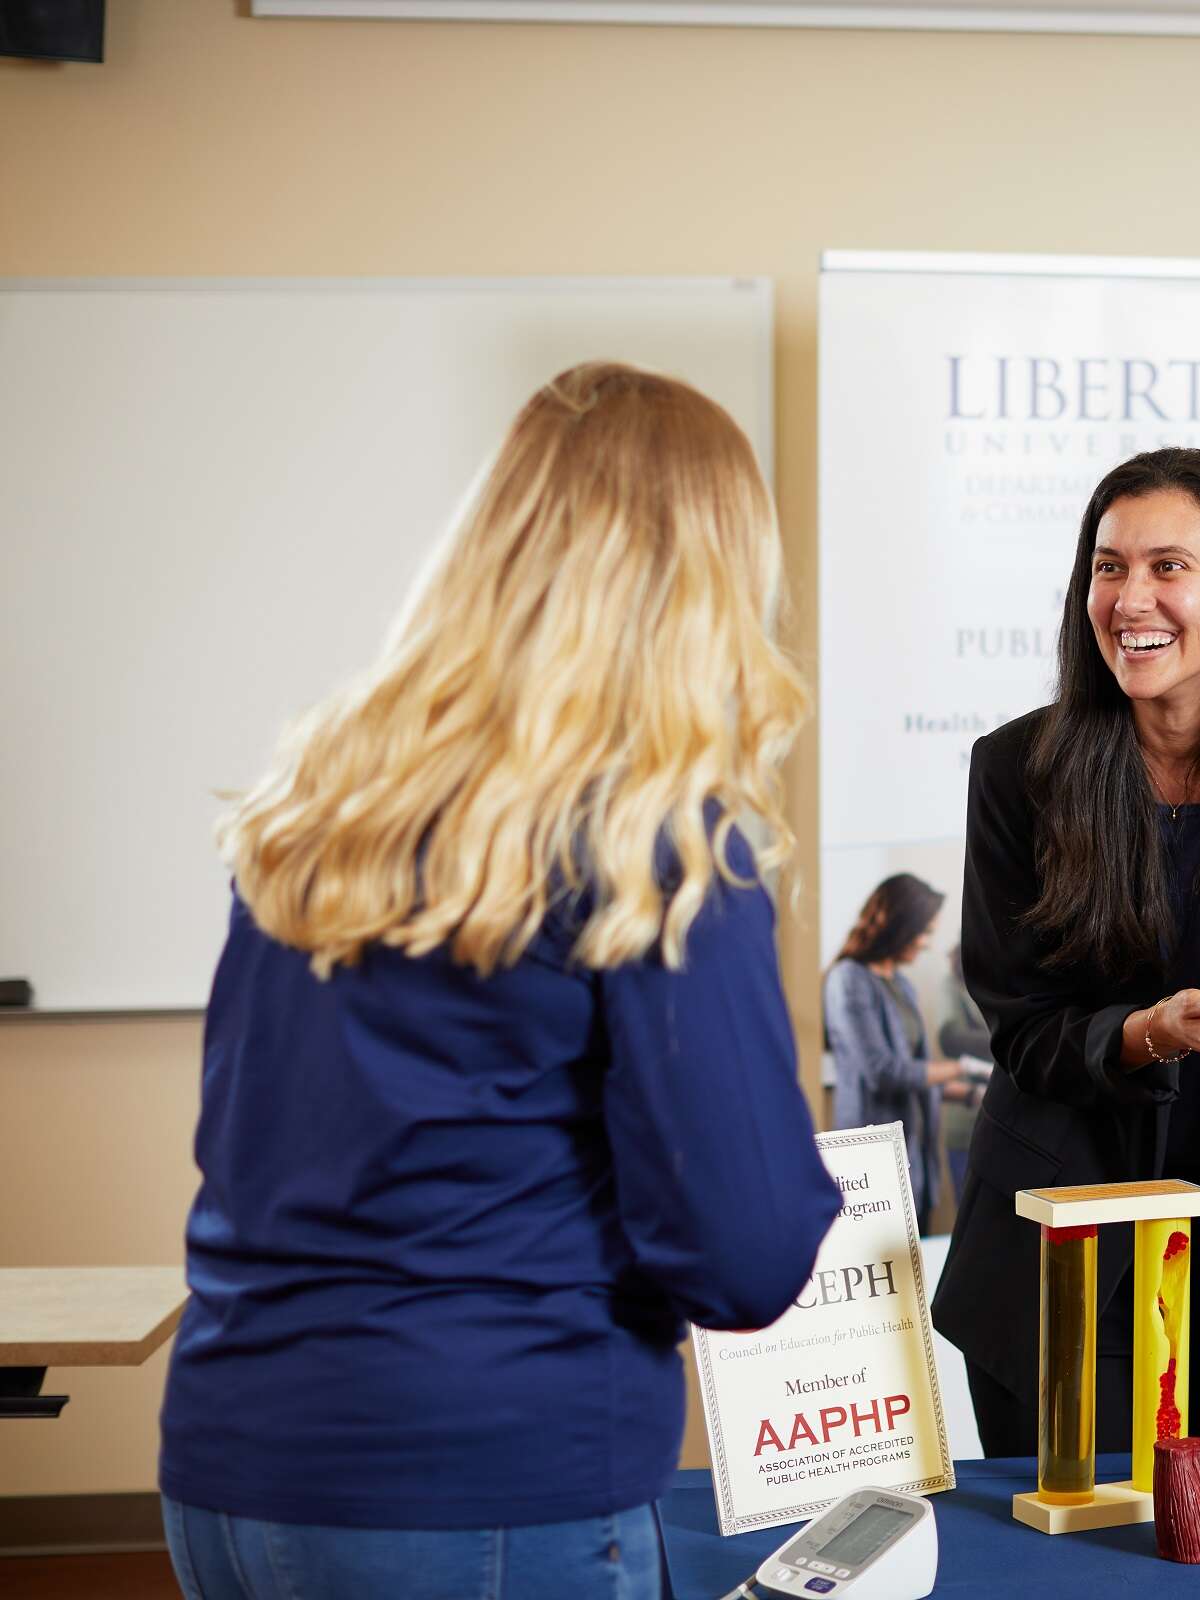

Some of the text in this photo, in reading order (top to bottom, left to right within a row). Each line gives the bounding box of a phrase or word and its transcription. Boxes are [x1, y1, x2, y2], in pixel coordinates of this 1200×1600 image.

[904, 712, 986, 733] Health
[719, 1317, 914, 1361] Council on Education for Public Health
[785, 1366, 867, 1397] Member of
[753, 1394, 911, 1457] AAPHP
[758, 1436, 914, 1474] ASSOCIATION OF ACCREDITED
[766, 1450, 911, 1486] PUBLIC HEALTH PROGRAMS
